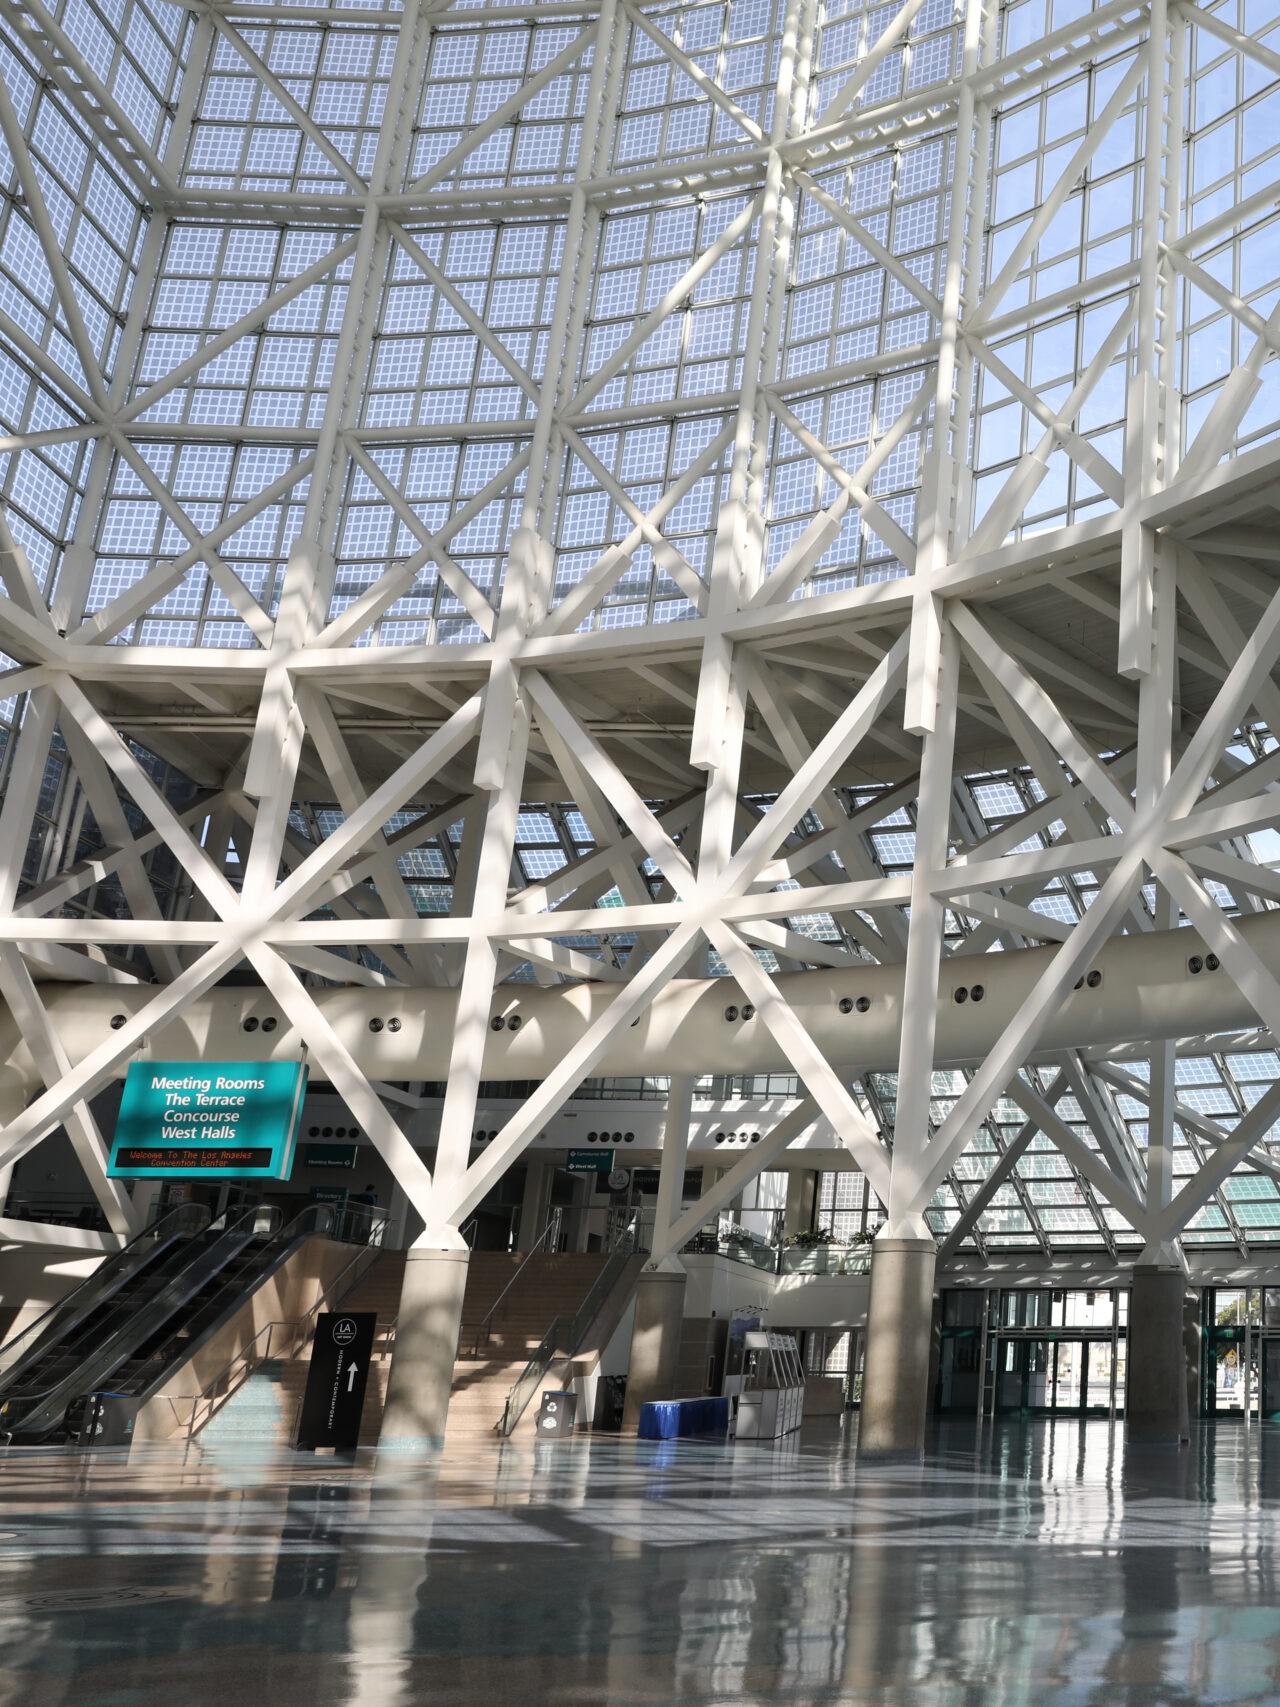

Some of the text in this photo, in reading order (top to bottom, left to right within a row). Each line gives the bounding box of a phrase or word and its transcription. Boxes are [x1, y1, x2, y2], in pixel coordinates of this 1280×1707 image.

[151, 1077, 265, 1092] Meeting Rooms
[165, 1093, 246, 1106] The Terrace
[164, 1109, 240, 1122] Concourse
[161, 1126, 236, 1139] West Halls
[130, 1151, 163, 1159] Welcome
[168, 1151, 178, 1159] To
[183, 1151, 198, 1159] The
[201, 1151, 217, 1159] Los
[151, 1159, 196, 1167] Convention
[339, 1323, 351, 1333] LA
[336, 1349, 344, 1375] MODERN
[327, 1381, 339, 1429] CONTEMPORARY
